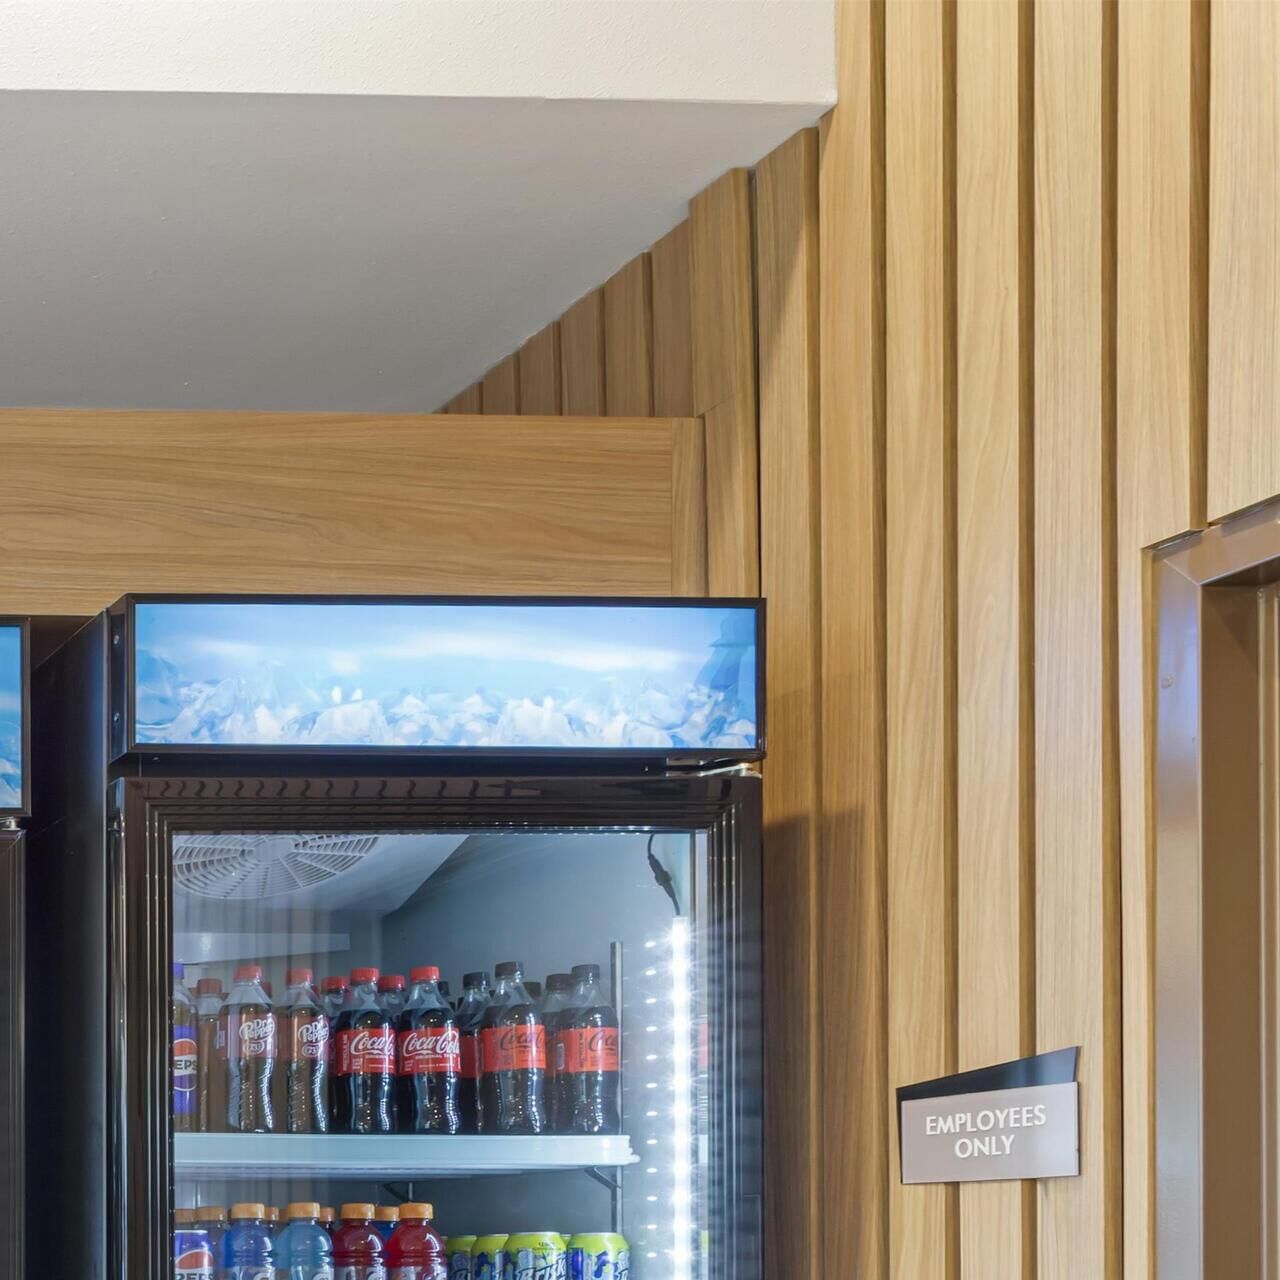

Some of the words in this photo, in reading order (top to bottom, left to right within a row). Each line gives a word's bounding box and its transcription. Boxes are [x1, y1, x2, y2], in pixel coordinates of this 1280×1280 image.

[175, 1059, 197, 1070] EPS
[926, 1105, 1047, 1136] EMPLOYEES
[955, 1134, 1015, 1158] ONLY
